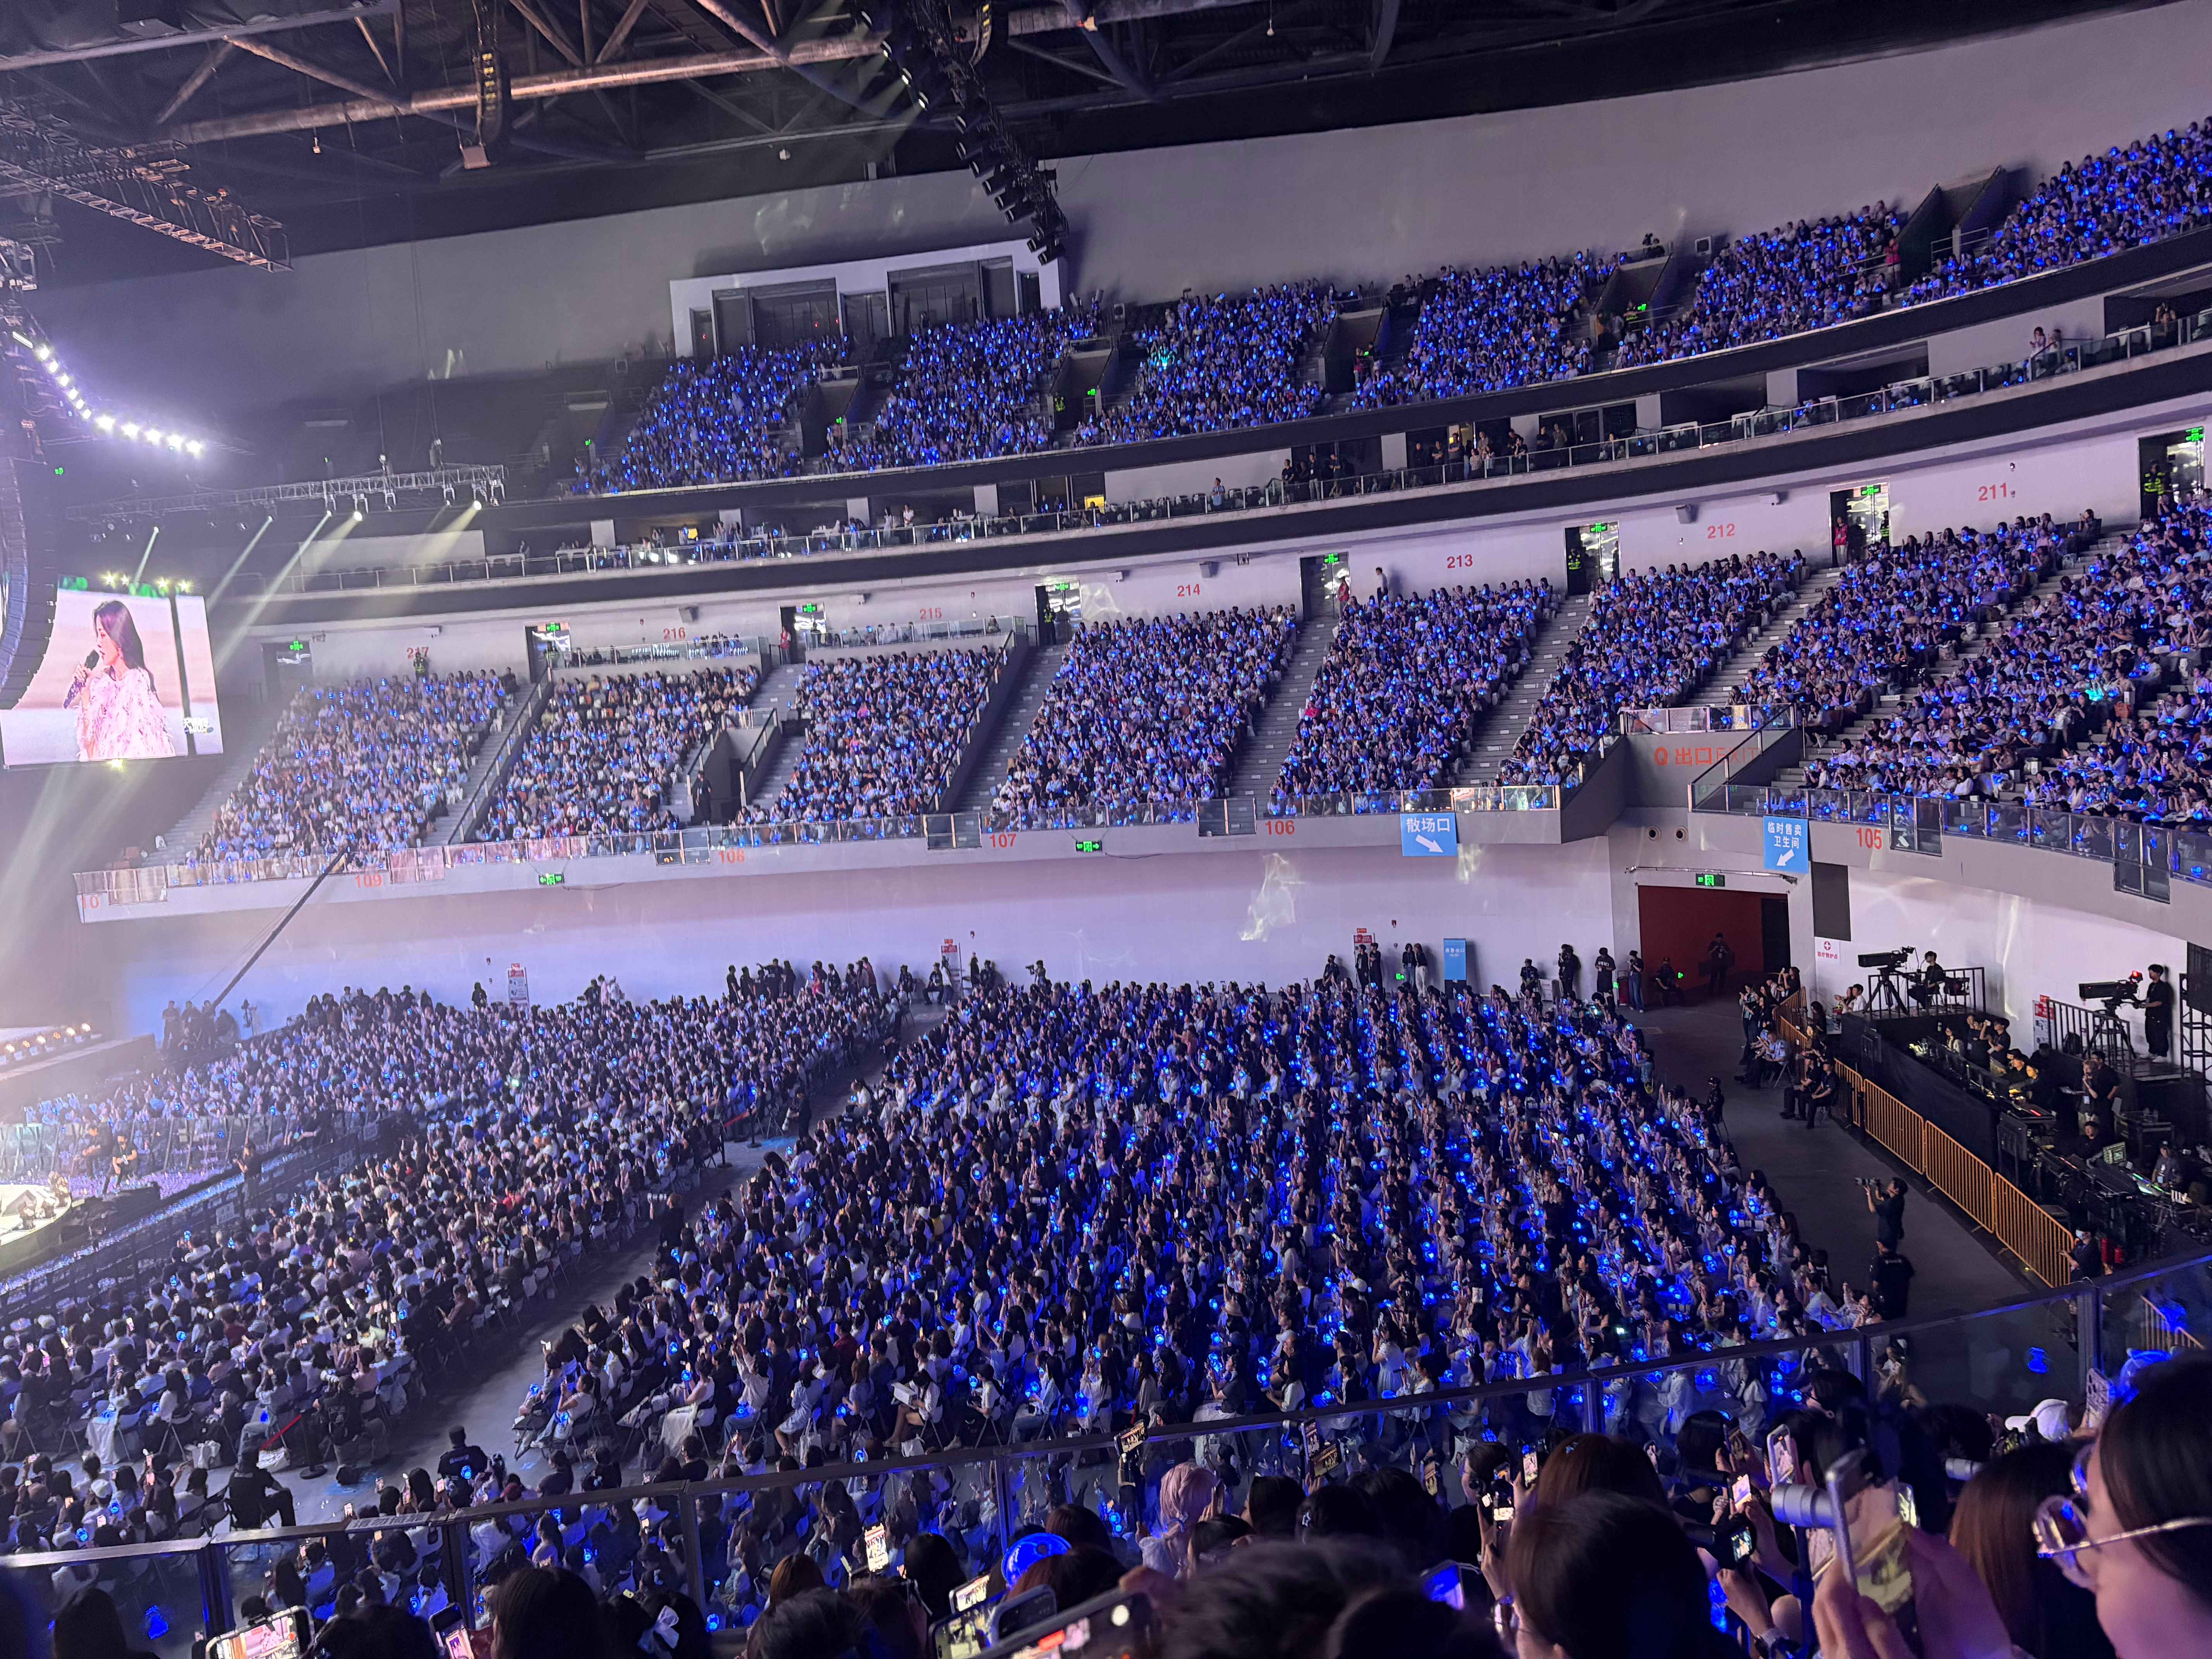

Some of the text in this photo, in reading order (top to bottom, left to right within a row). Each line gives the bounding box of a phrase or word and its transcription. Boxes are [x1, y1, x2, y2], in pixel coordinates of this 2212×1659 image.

[1978, 483, 2007, 501] 211
[1707, 523, 1735, 539] 212
[1447, 554, 1473, 569] 213
[1177, 583, 1200, 597] 214
[920, 607, 942, 620] 215
[663, 627, 686, 640] 216
[1654, 746, 1759, 766] Q 出口 EXIT
[1265, 820, 1295, 835] 106
[1406, 817, 1450, 833] 散场口
[1767, 821, 1802, 836] 临时售卖
[989, 833, 1017, 848] 107
[1774, 835, 1799, 849] 卫生间
[1856, 827, 1882, 850] 105
[355, 873, 383, 888] 109
